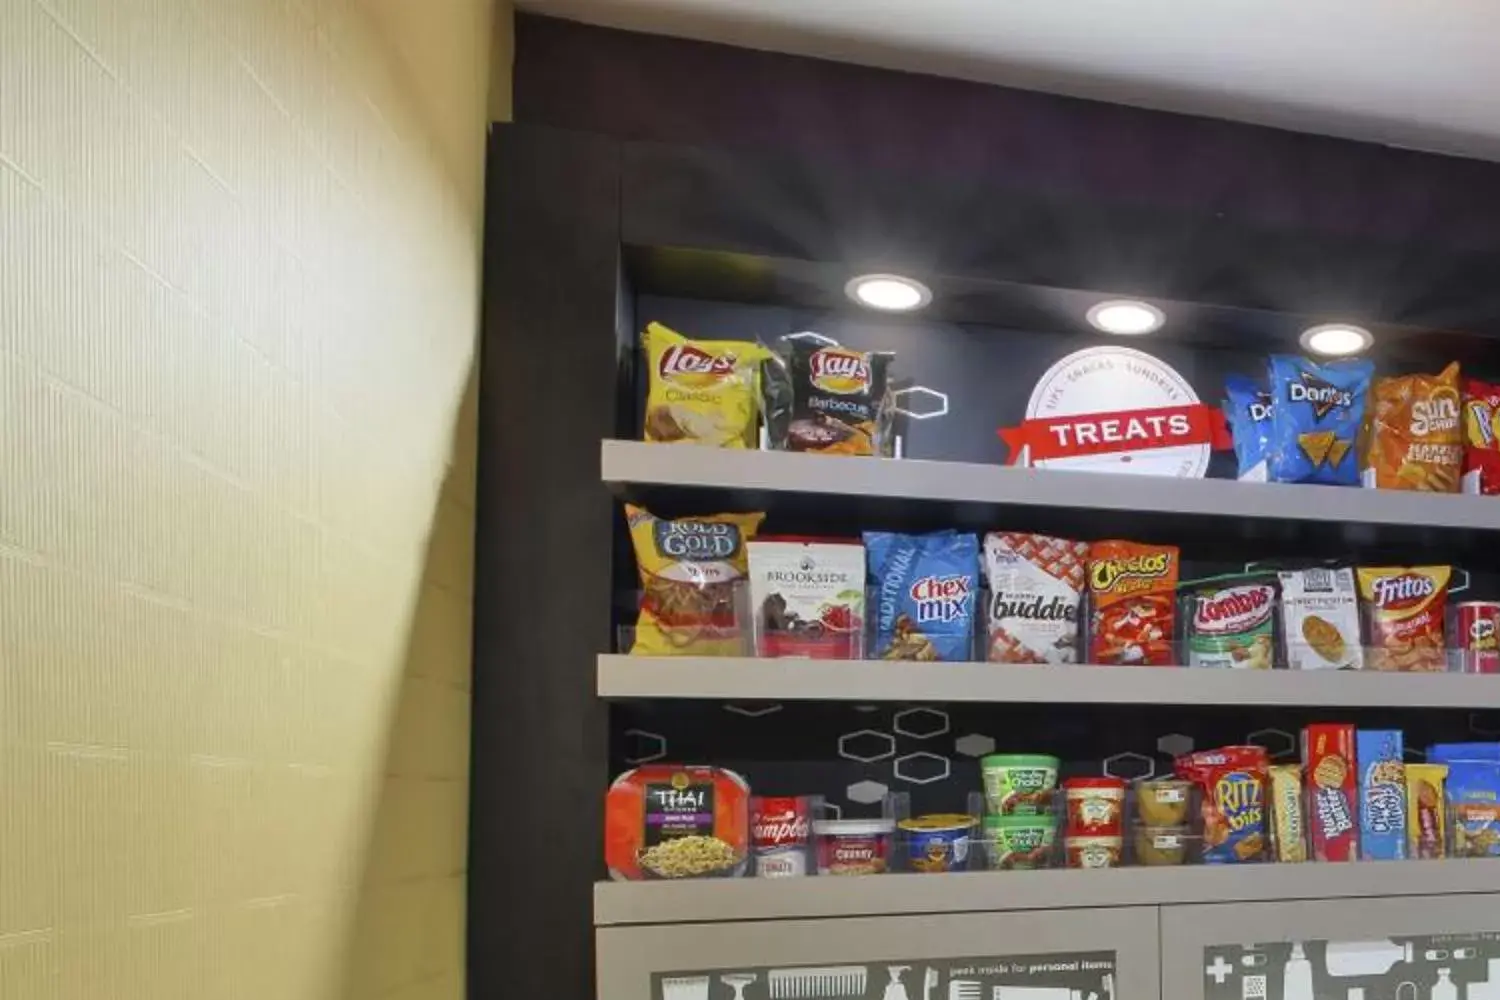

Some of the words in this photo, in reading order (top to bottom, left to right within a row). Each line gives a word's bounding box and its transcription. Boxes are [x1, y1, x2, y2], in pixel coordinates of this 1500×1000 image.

[1290, 380, 1352, 408] Doritos
[1049, 413, 1191, 447] TREATS
[663, 534, 735, 557] GOLD
[766, 571, 850, 585] BROOKSIDE
[910, 575, 972, 601] Chex
[1372, 576, 1434, 607] Fritos
[916, 598, 969, 623] mix
[653, 789, 705, 809] THAI
[1216, 780, 1260, 812] RITZ
[1029, 960, 1079, 975] personal
[1081, 960, 1113, 970] items
